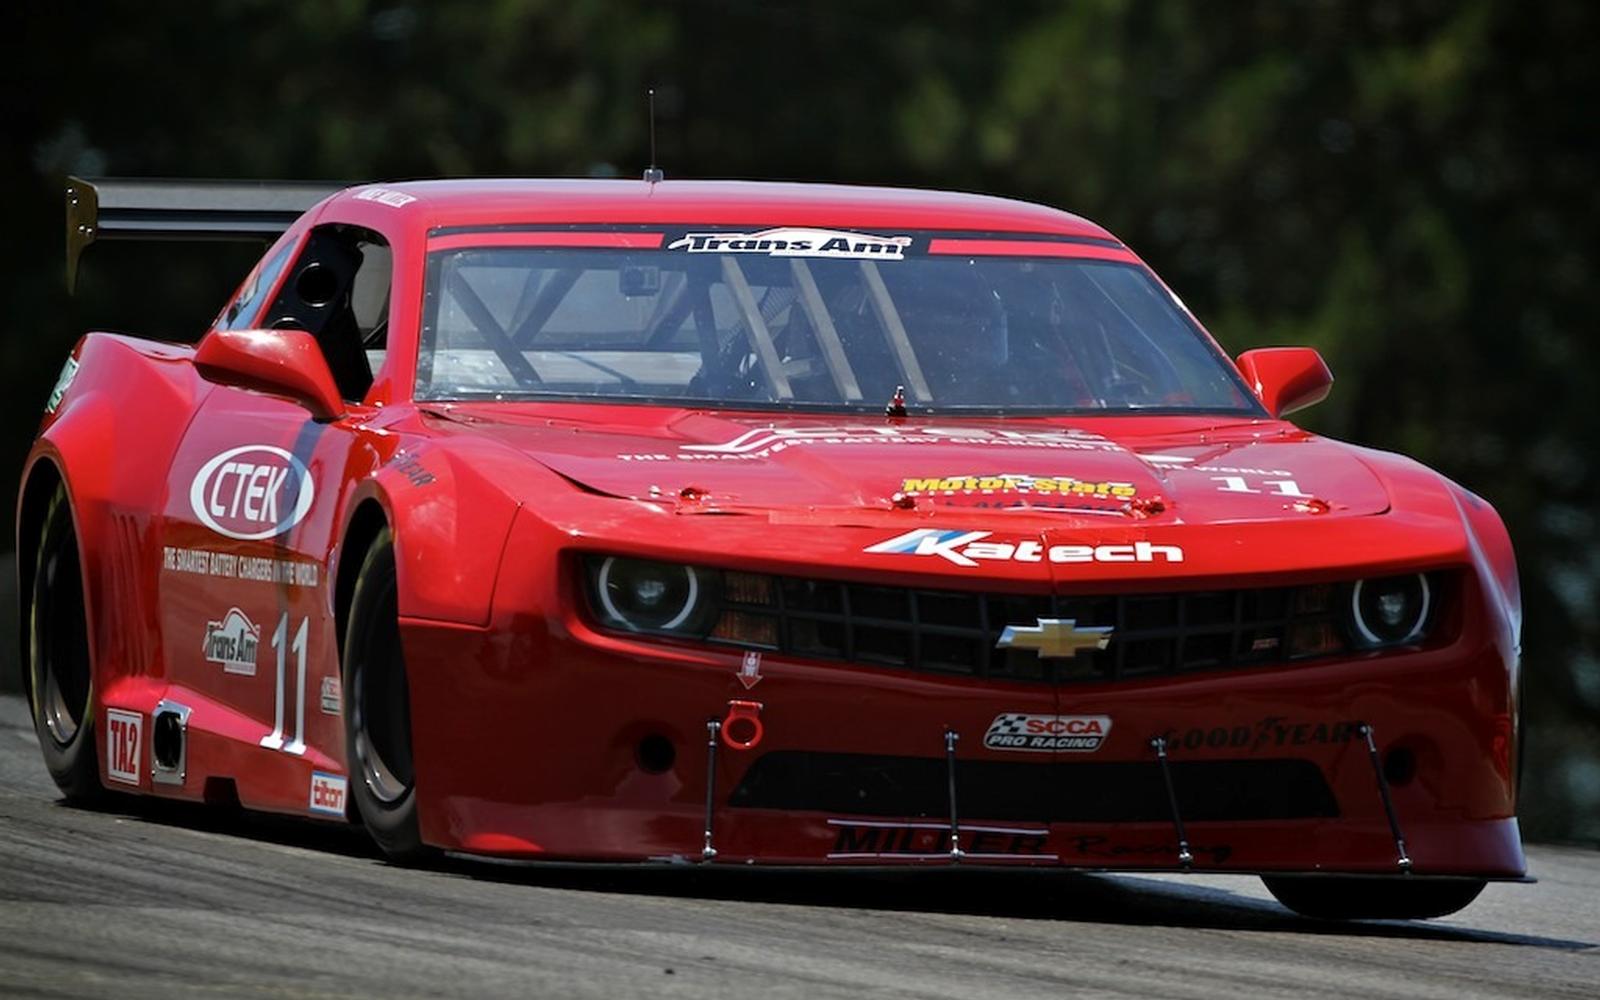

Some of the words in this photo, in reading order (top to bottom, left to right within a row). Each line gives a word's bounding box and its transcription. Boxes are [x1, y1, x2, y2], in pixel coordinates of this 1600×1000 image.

[689, 235, 814, 251] Trans
[818, 237, 899, 254] Am
[1193, 465, 1292, 477] WORLD
[210, 462, 289, 523] CTEK
[903, 477, 1017, 492] Motor
[1210, 476, 1314, 498] 11
[910, 530, 1184, 567] Katech
[207, 625, 236, 661] Trans
[236, 628, 257, 664] Am
[260, 611, 309, 756] 11
[1026, 719, 1103, 734] SCCA
[111, 719, 137, 775] TA2
[988, 735, 1027, 746] PRO
[1030, 737, 1100, 749] RACING
